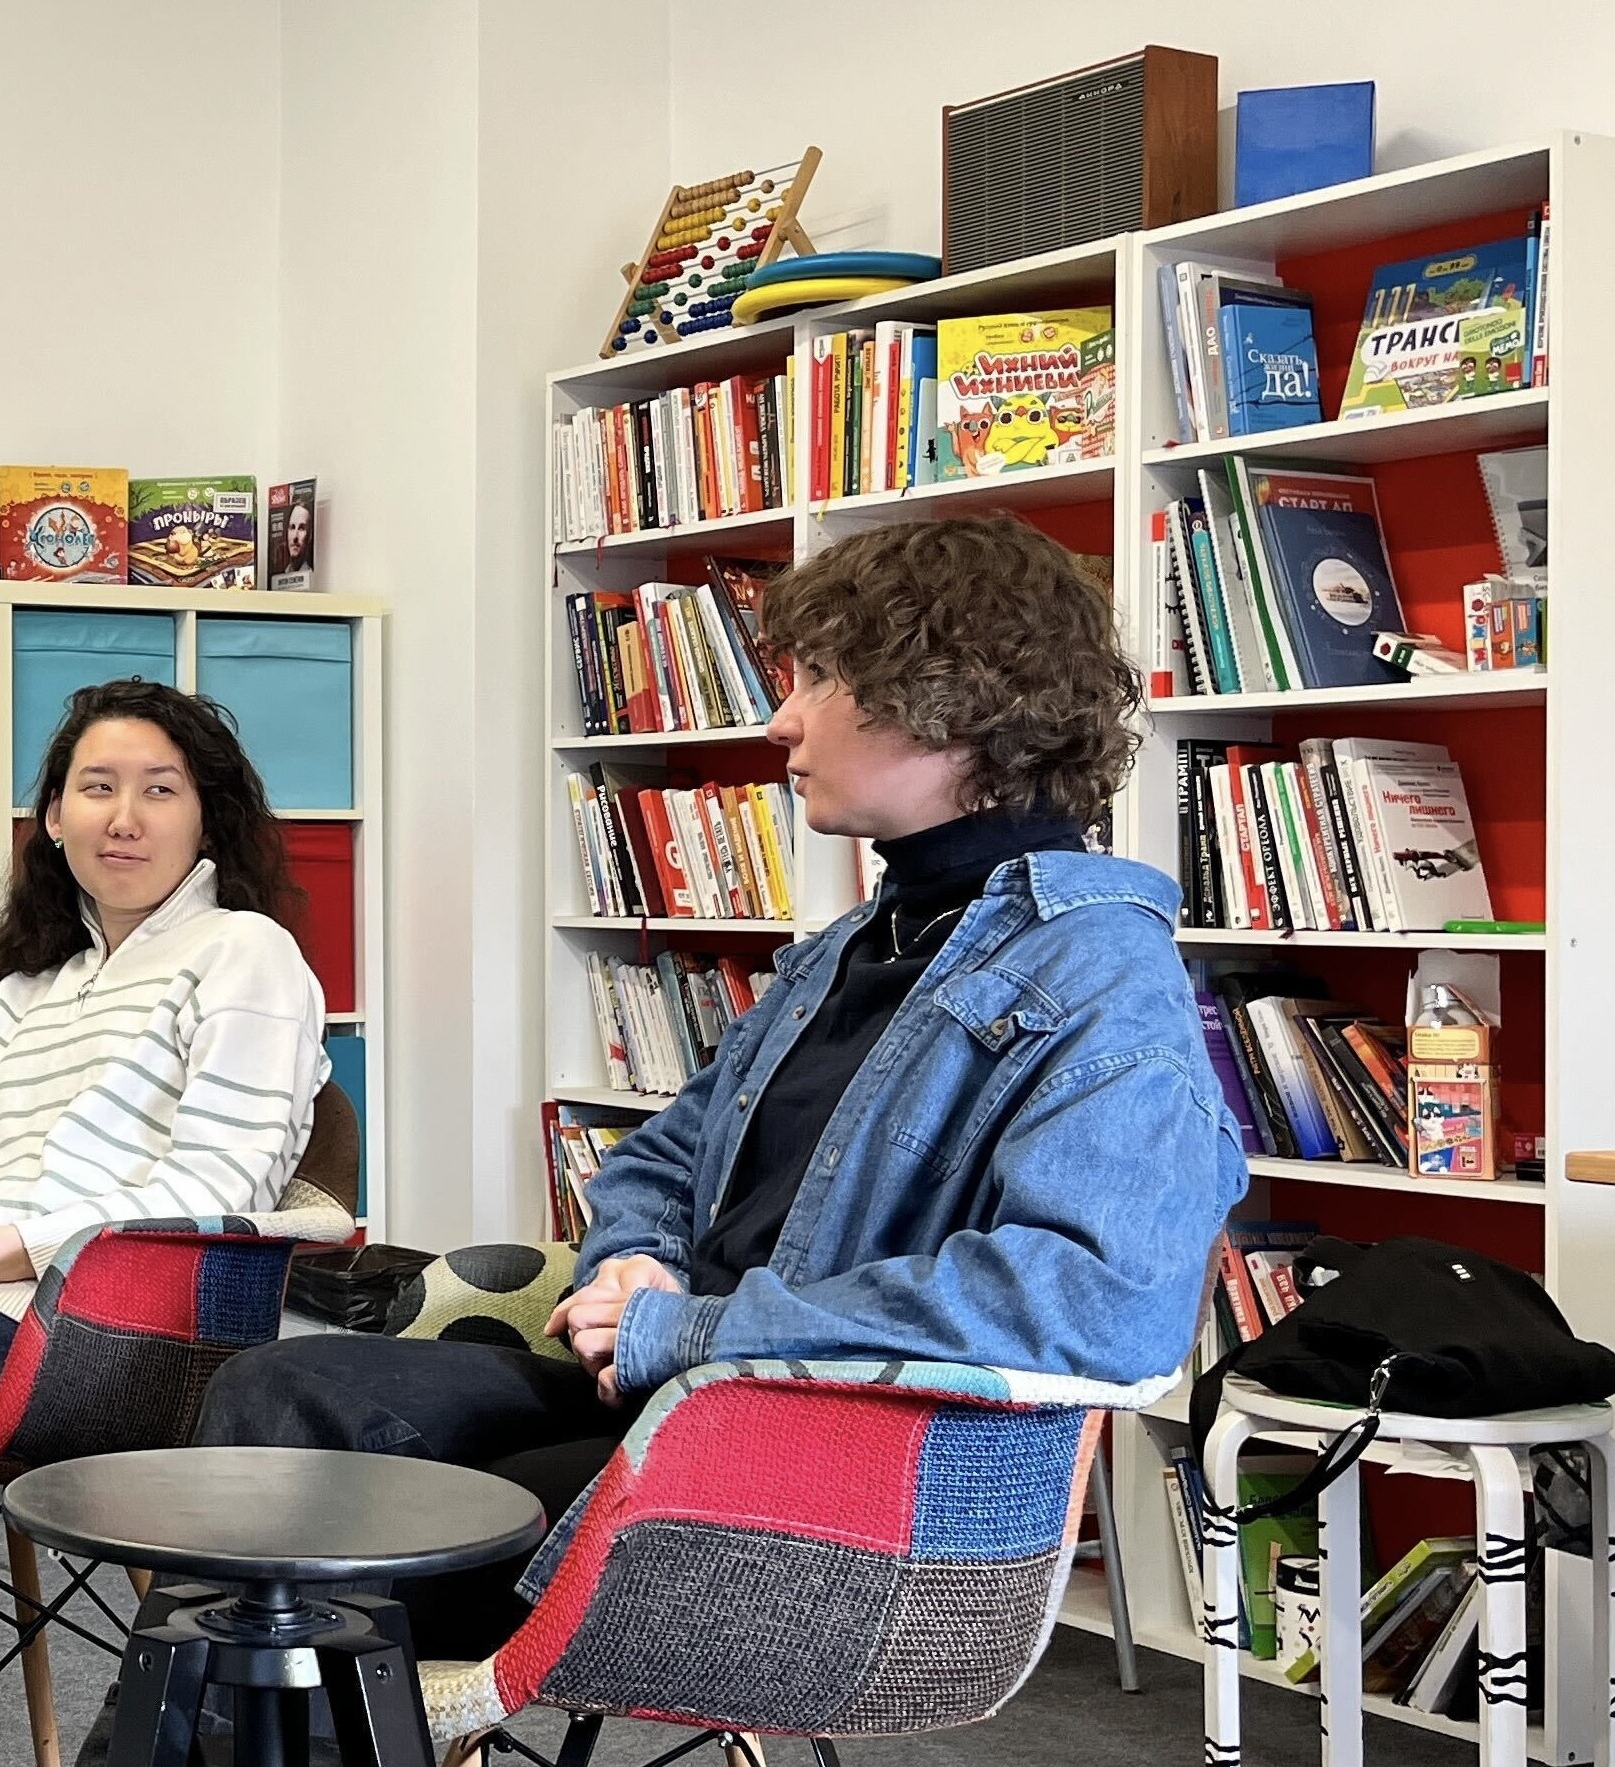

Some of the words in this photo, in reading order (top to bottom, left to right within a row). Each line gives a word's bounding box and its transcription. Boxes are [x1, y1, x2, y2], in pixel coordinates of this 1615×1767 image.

[978, 346, 1078, 375] ИХНИЙ
[1206, 326, 1219, 356] ДАО
[1247, 349, 1303, 365] Сказать
[1390, 352, 1439, 373] ВОКРУГ
[1443, 352, 1460, 363] НА
[1262, 362, 1312, 401] да!
[153, 511, 229, 531] ПРОНЫРЫ
[1178, 754, 1188, 803] ТРАМП
[1307, 763, 1323, 807] СТРАТЕГИЯ
[1382, 791, 1421, 805] Ничего
[597, 785, 618, 847] Рисование
[1236, 804, 1250, 851] СТАРТАП
[1345, 780, 1363, 844] УДОВОЛЬСТВИЕ
[1409, 805, 1456, 817] лишнего
[574, 809, 589, 867] СТРАТЕГИЧЕСКАЯ
[1259, 815, 1272, 861] ОРЕОЛА
[1317, 809, 1337, 873] КОНКУРЕНТНАЯ
[1267, 866, 1280, 912] ЭФФЕКТ
